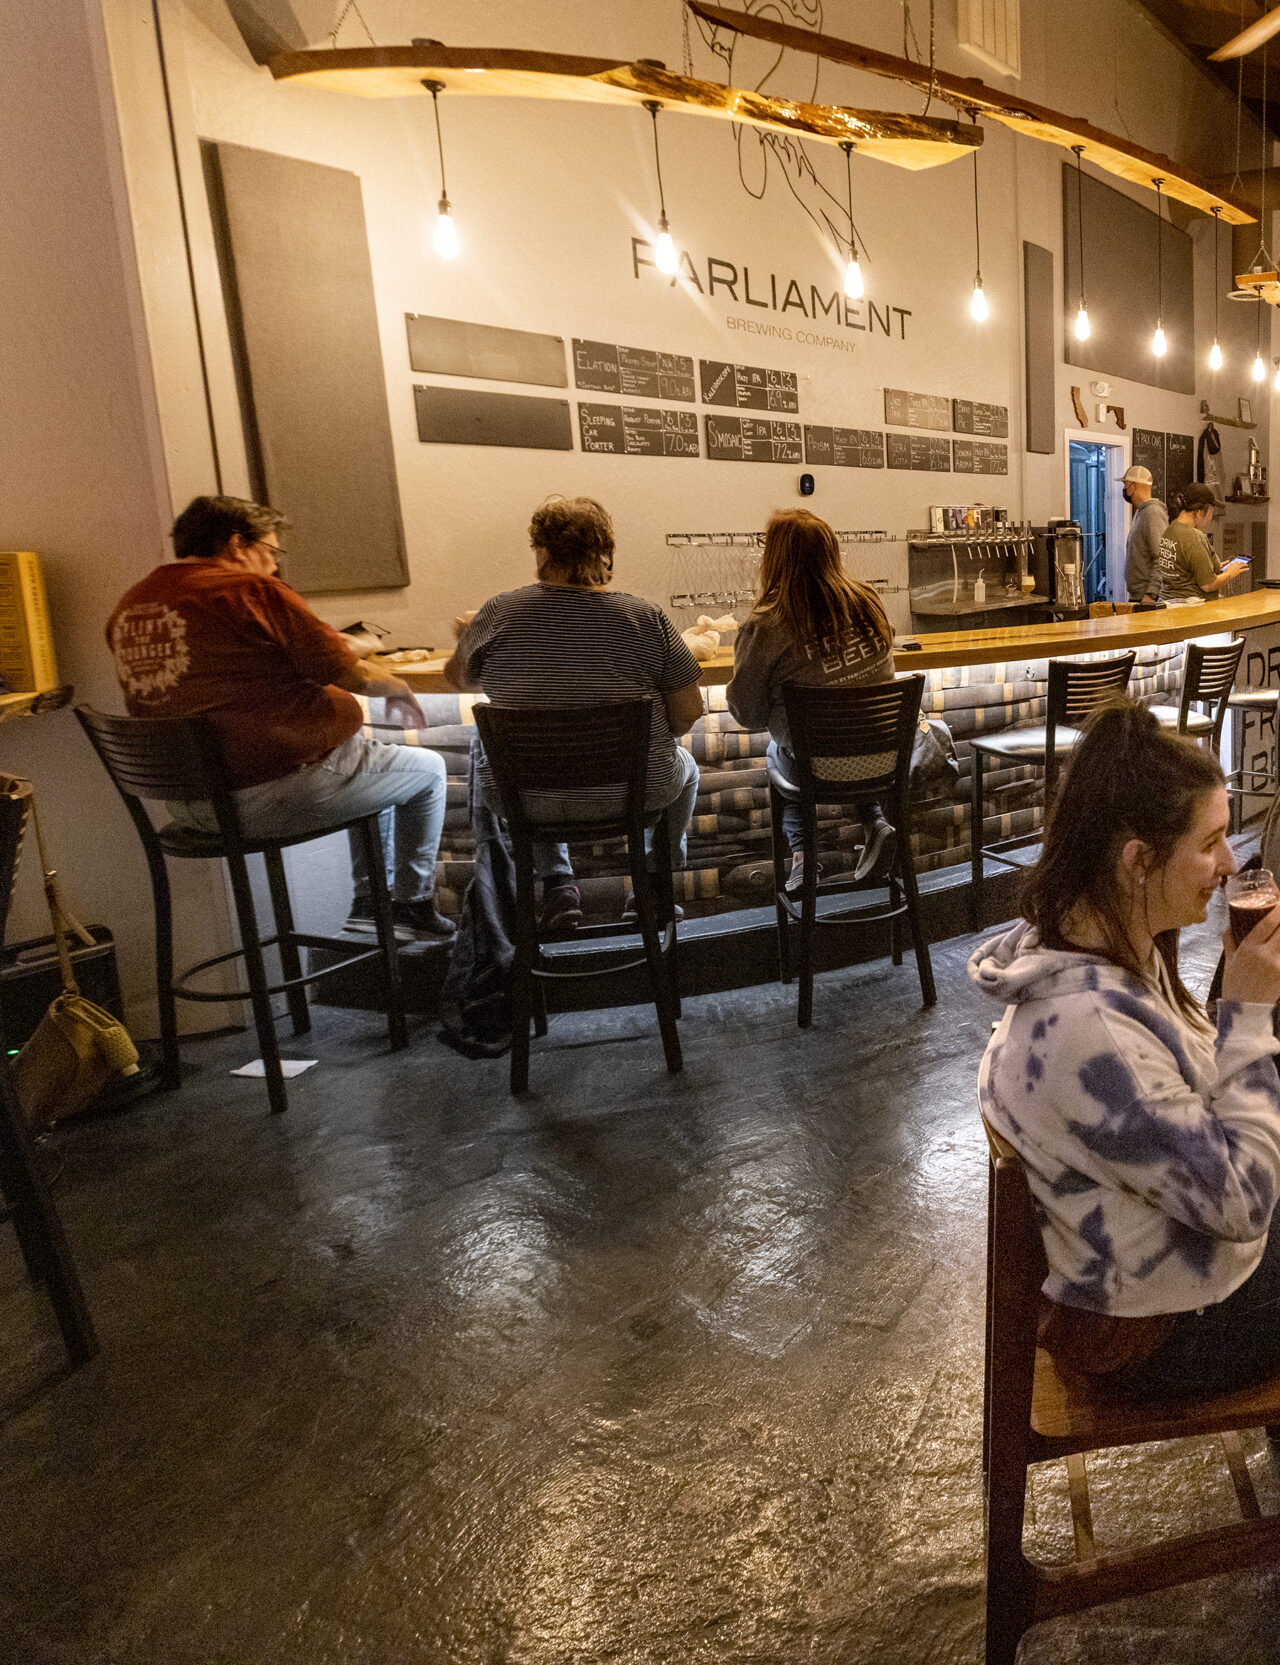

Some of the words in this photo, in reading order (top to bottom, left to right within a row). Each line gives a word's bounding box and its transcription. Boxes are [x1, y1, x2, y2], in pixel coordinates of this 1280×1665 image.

[631, 236, 912, 340] PARLIAMENT
[727, 315, 792, 341] BREWING
[796, 330, 856, 352] COMPANY
[581, 408, 616, 427] SLEEPING
[583, 426, 598, 437] CAR
[756, 424, 768, 437] IPA
[584, 437, 615, 452] PORTER
[807, 433, 830, 452] PRISM
